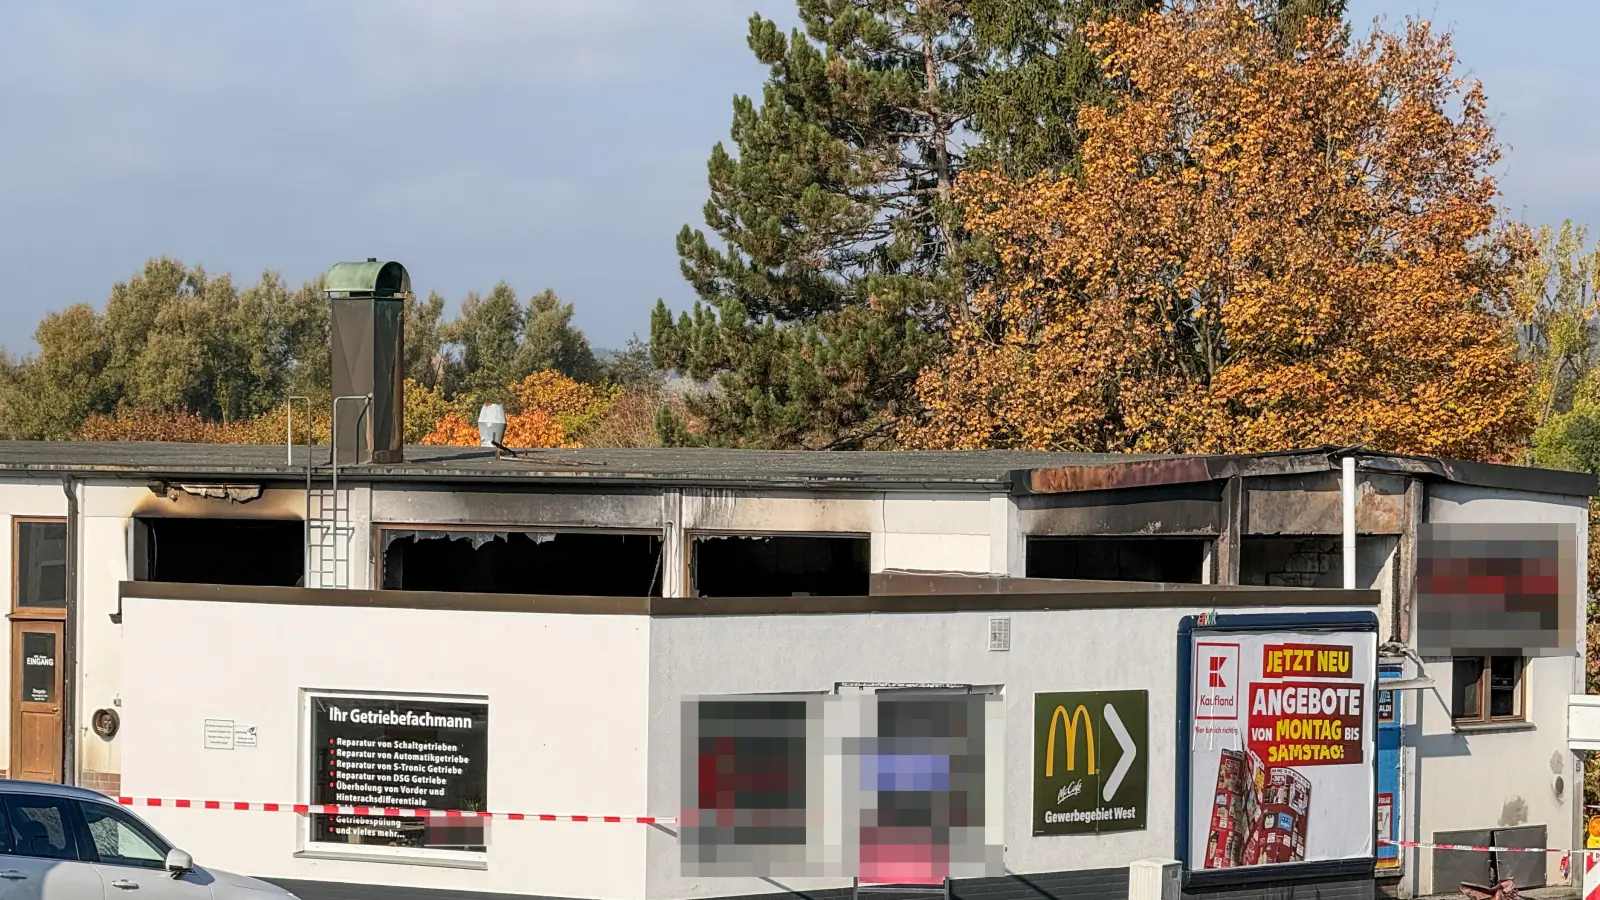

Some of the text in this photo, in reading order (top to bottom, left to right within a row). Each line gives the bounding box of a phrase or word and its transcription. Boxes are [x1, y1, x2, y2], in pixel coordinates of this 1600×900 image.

[26, 657, 54, 666] EINGANG
[1266, 649, 1349, 673] JETZT NEU
[1200, 694, 1234, 706] Kaufland
[1252, 686, 1361, 716] ANGEBOTE
[329, 706, 472, 729] Ihr Getriebefachmann
[1251, 719, 1360, 742] VON MONTAG BIS
[336, 738, 376, 748] Reparatur
[393, 740, 458, 752] Schaltgetrieben
[336, 748, 376, 758] Reparatur
[393, 752, 470, 764] Automatikgetriebe
[336, 760, 376, 770] Reparatur
[393, 762, 426, 772] S-Tronic
[427, 764, 463, 774] Getriebe
[336, 770, 376, 780] Reparatur
[393, 774, 410, 784] DSG
[411, 774, 447, 784] Getriebe
[336, 780, 382, 793] Überholung
[400, 786, 427, 796] Vorder
[428, 788, 445, 796] und
[336, 793, 427, 806] Hinterachsdifferentiale
[336, 816, 401, 828] Getriebespülung
[1045, 806, 1136, 823] Gewerbegebiet West
